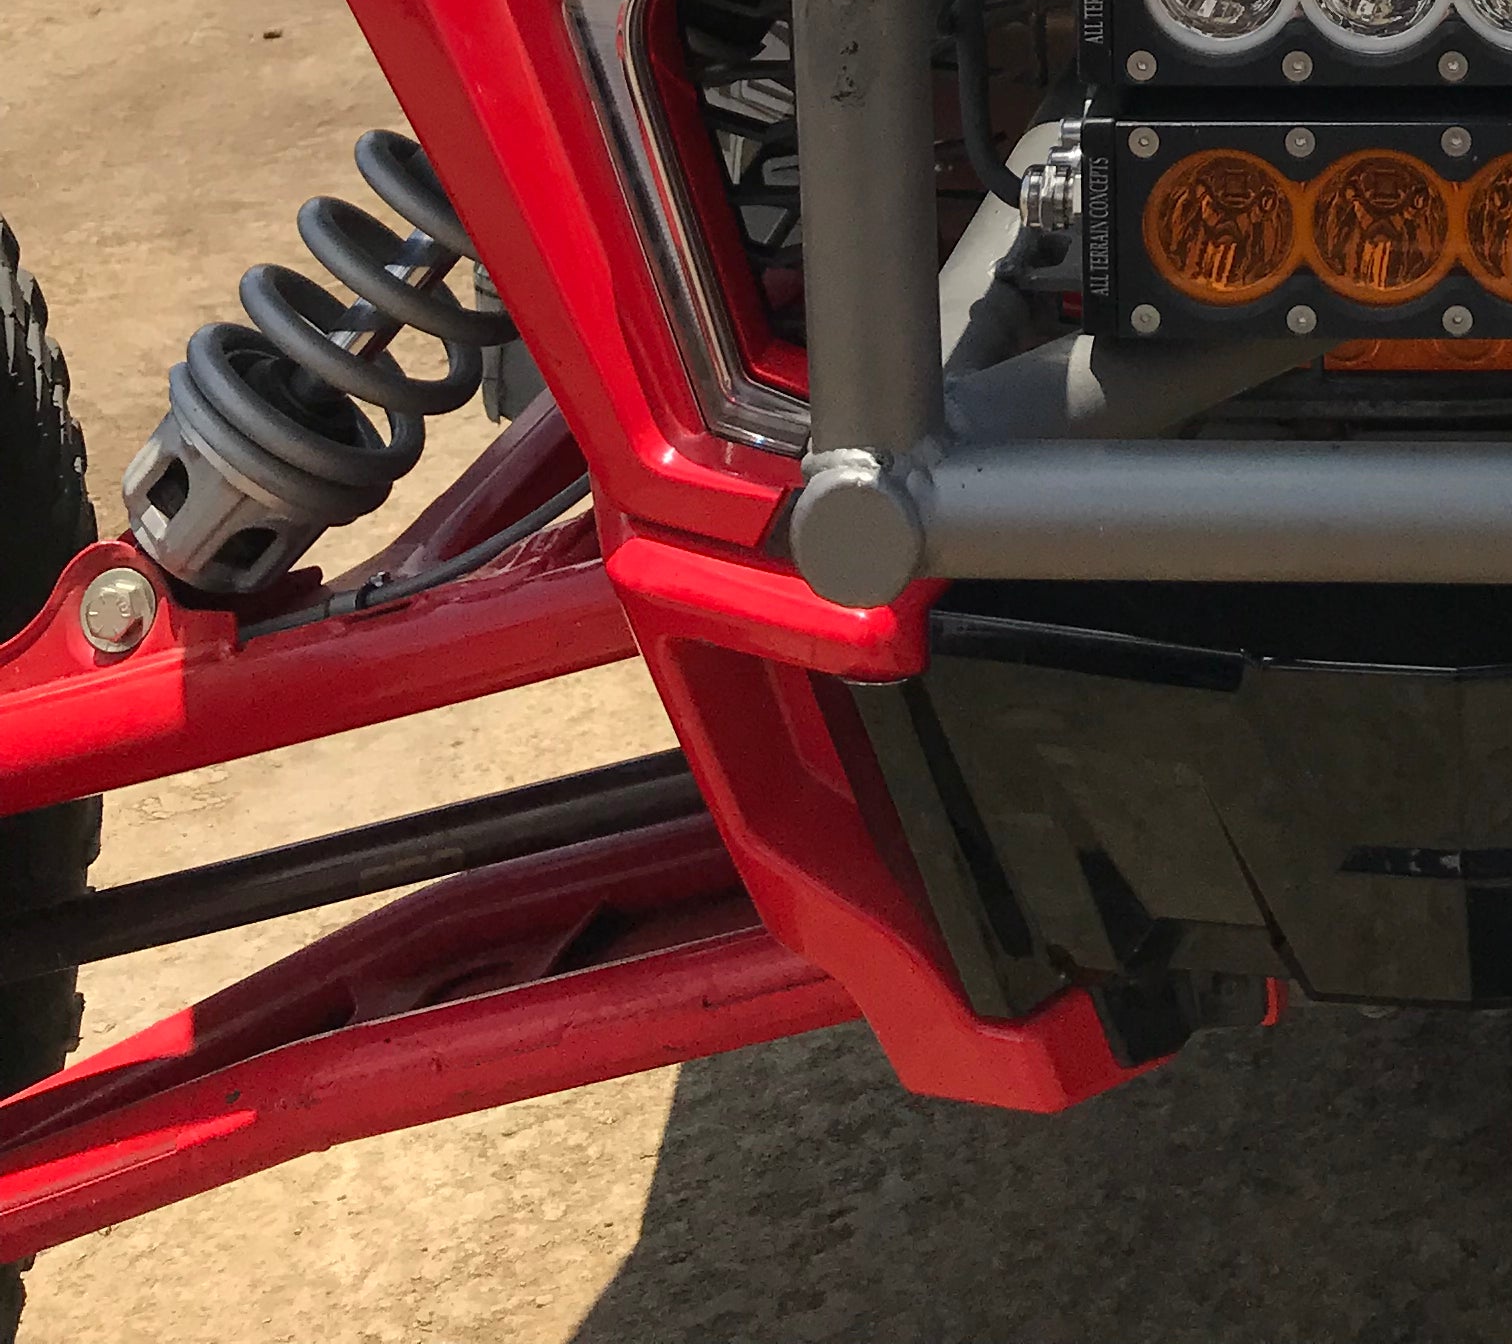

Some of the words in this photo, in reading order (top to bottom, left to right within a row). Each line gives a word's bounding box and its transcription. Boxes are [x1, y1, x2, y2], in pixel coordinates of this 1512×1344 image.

[1084, 20, 1104, 44] ALL
[1089, 156, 1110, 219] CONCEPTS
[1089, 220, 1110, 272] TERRAIN
[1089, 274, 1110, 297] ALL
